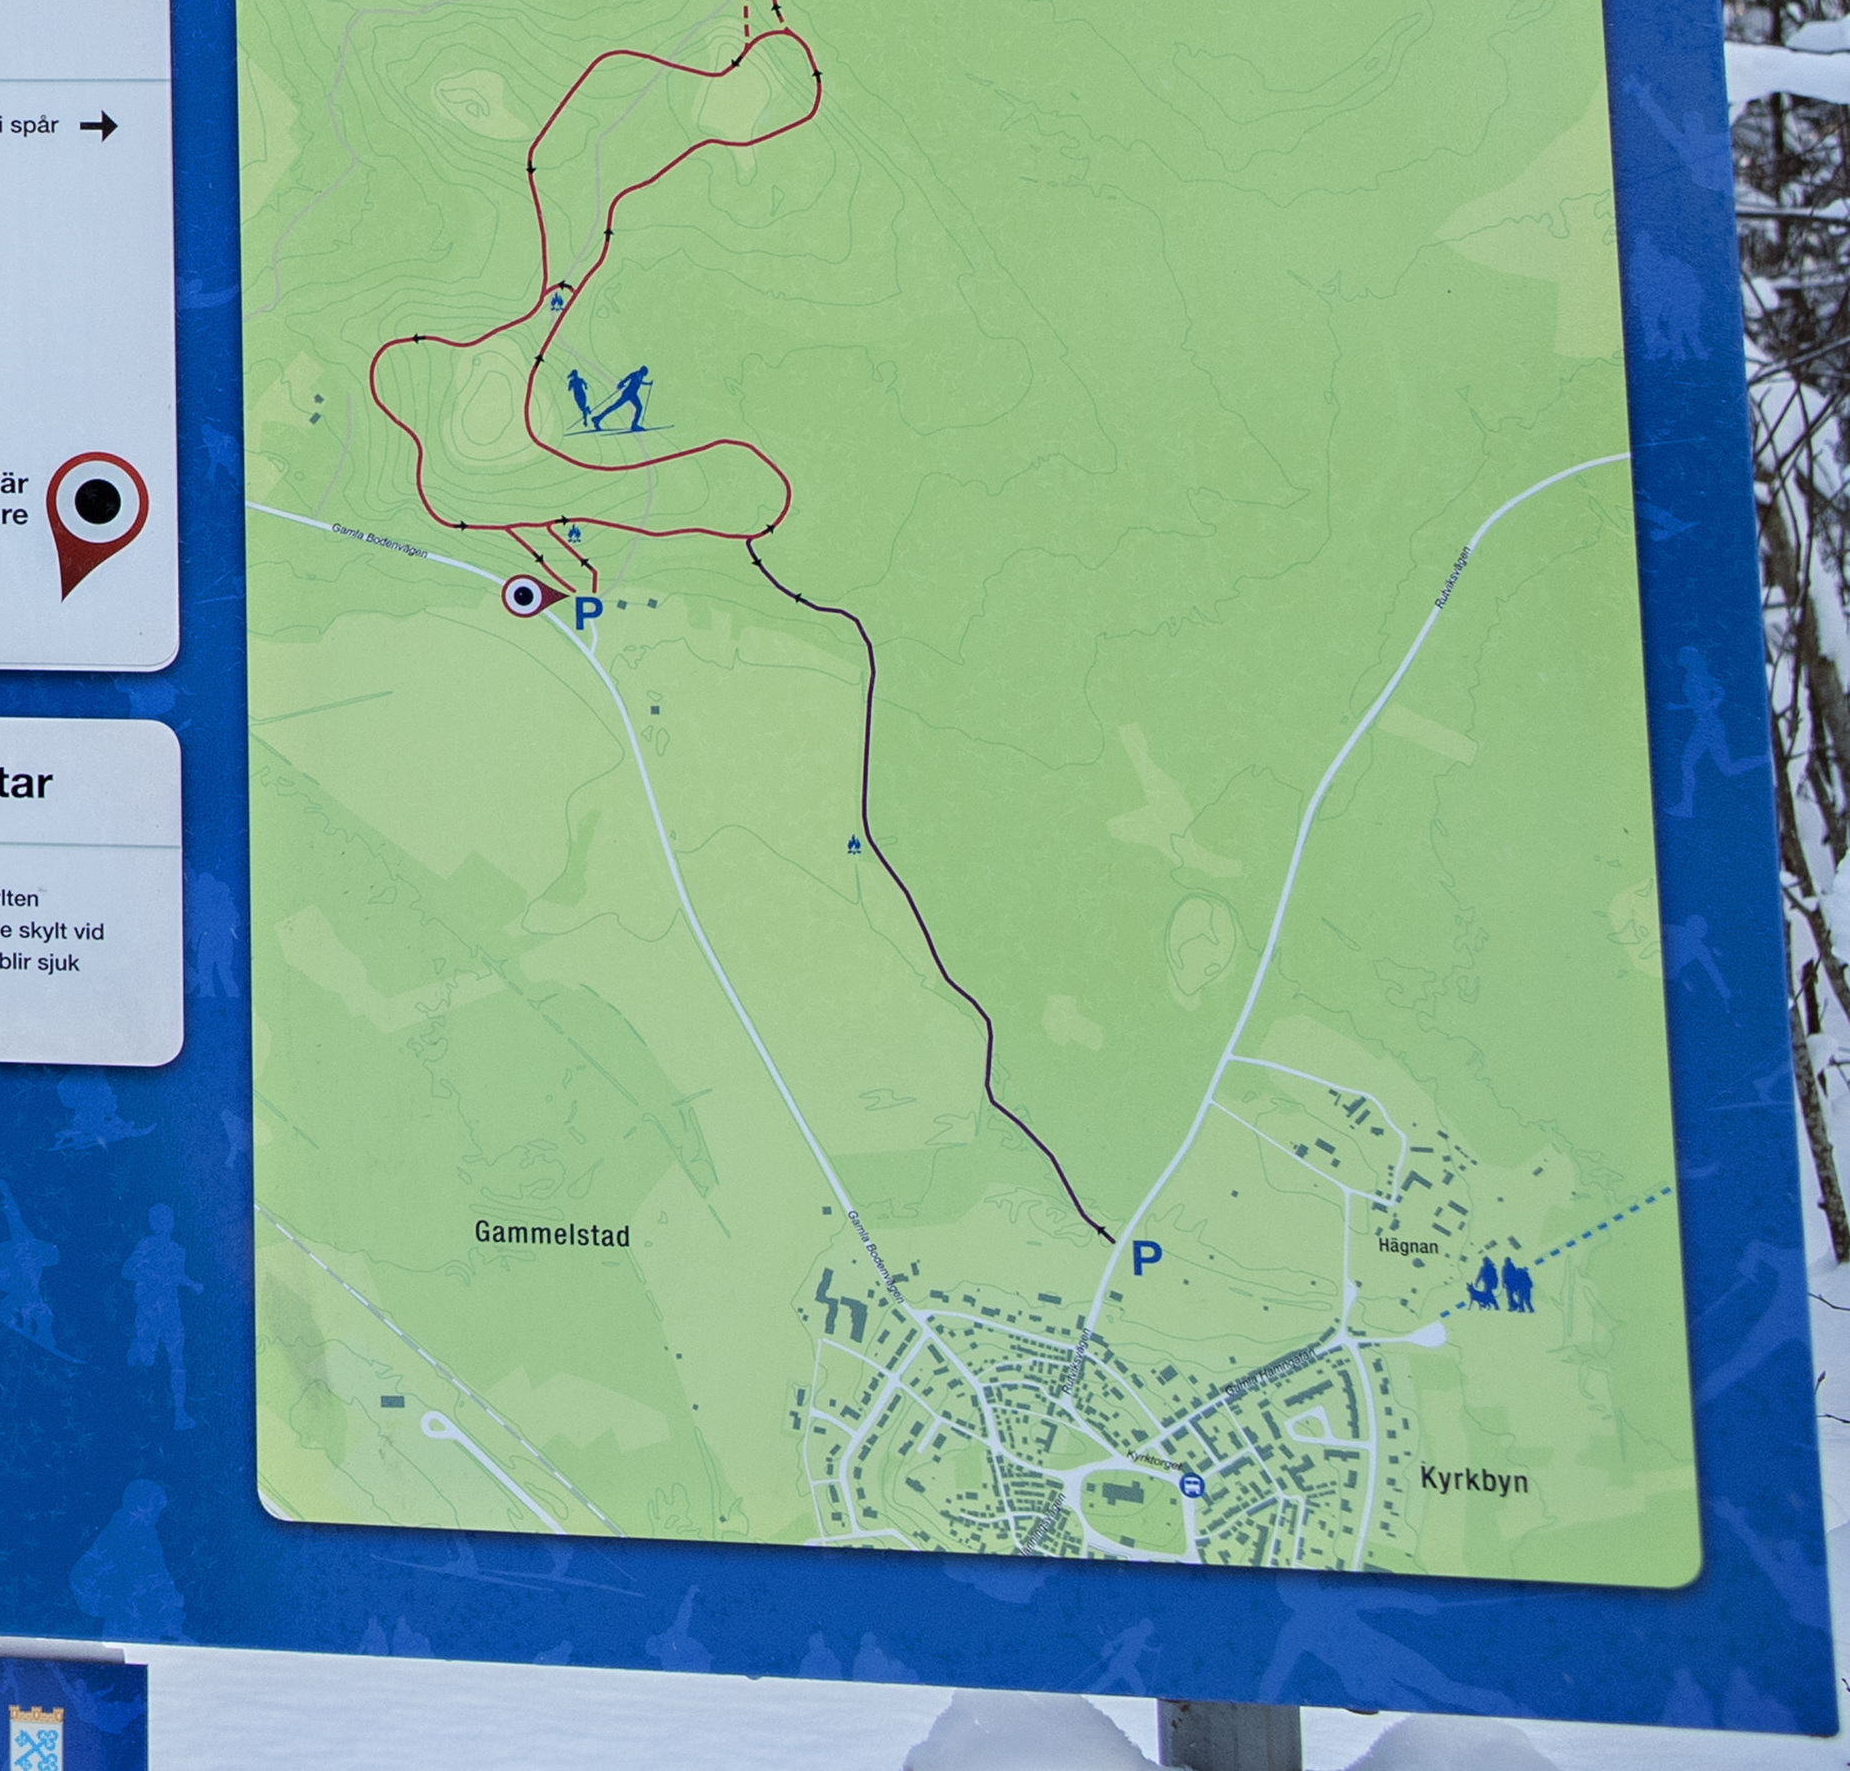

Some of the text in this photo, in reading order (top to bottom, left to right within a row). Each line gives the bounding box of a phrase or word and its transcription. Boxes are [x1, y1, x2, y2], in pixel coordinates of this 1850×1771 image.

[10, 114, 60, 138] spår
[331, 522, 364, 540] Gamla
[1434, 545, 1471, 609] Rutviksvägen
[575, 596, 604, 631] P
[19, 921, 68, 944] skylt
[73, 922, 105, 941] vid
[37, 953, 80, 976] sjuk
[475, 1219, 630, 1248] Gammelstad
[848, 1211, 870, 1242] Gamla
[1132, 1240, 1163, 1277] P
[1378, 1237, 1439, 1257] Hägnan
[1126, 1449, 1183, 1471] Kyrktorget
[1420, 1465, 1529, 1498] Kyrkbyn
